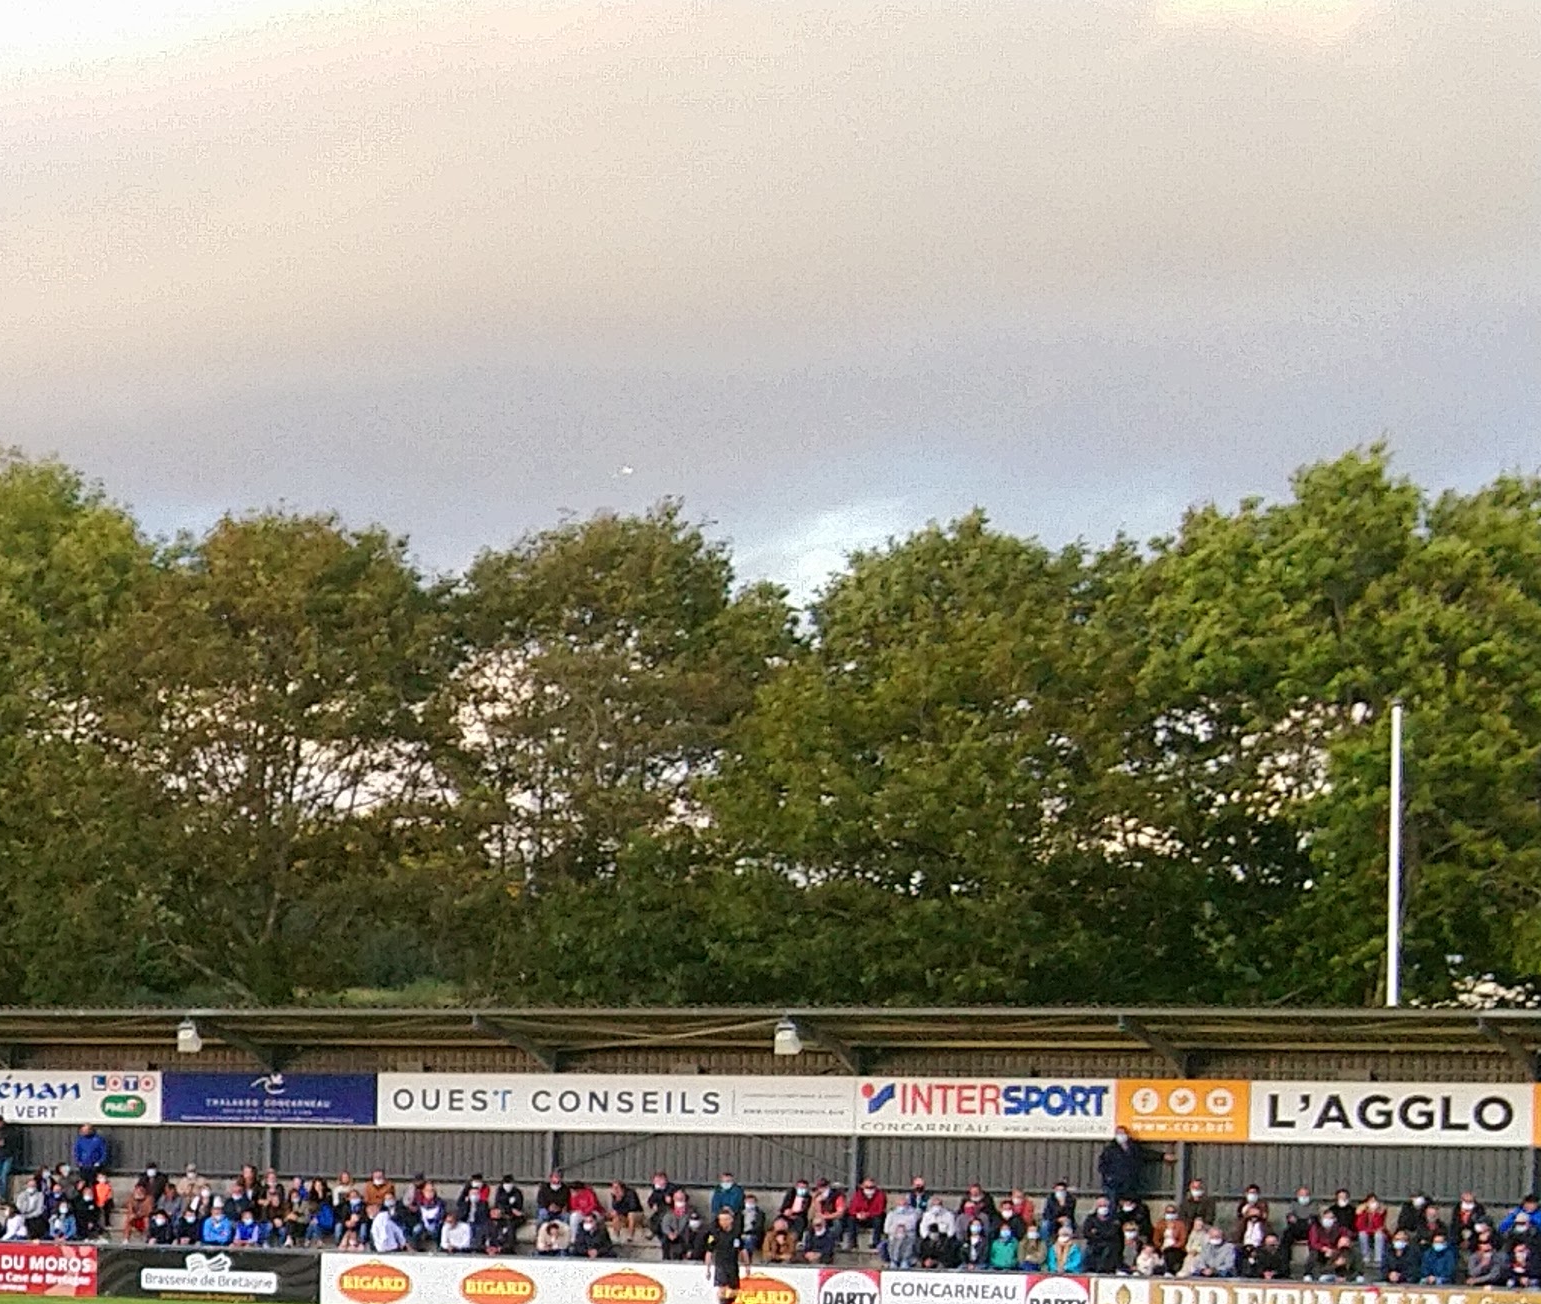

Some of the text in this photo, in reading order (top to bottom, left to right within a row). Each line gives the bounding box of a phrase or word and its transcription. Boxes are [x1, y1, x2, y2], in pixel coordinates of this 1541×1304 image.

[91, 1074, 156, 1092] LOTO
[392, 1088, 512, 1113] OUEST
[531, 1090, 720, 1115] CONSEILS
[899, 1084, 1109, 1116] INTERSPORT
[16, 1106, 59, 1119] VERT
[1267, 1094, 1514, 1130] L'AGGLO
[860, 1122, 989, 1133] CONCARNEAU
[1, 1255, 25, 1270] DU
[29, 1256, 91, 1273] MOROS
[5, 1272, 28, 1283] Cave
[45, 1274, 91, 1287] Bretagne
[145, 1272, 273, 1289] Brasserie de Bretagne
[343, 1276, 406, 1291] BIGARD
[464, 1280, 531, 1297] BIGARD
[591, 1284, 661, 1302] BIGARD
[890, 1281, 1017, 1301] CONCARNEAU
